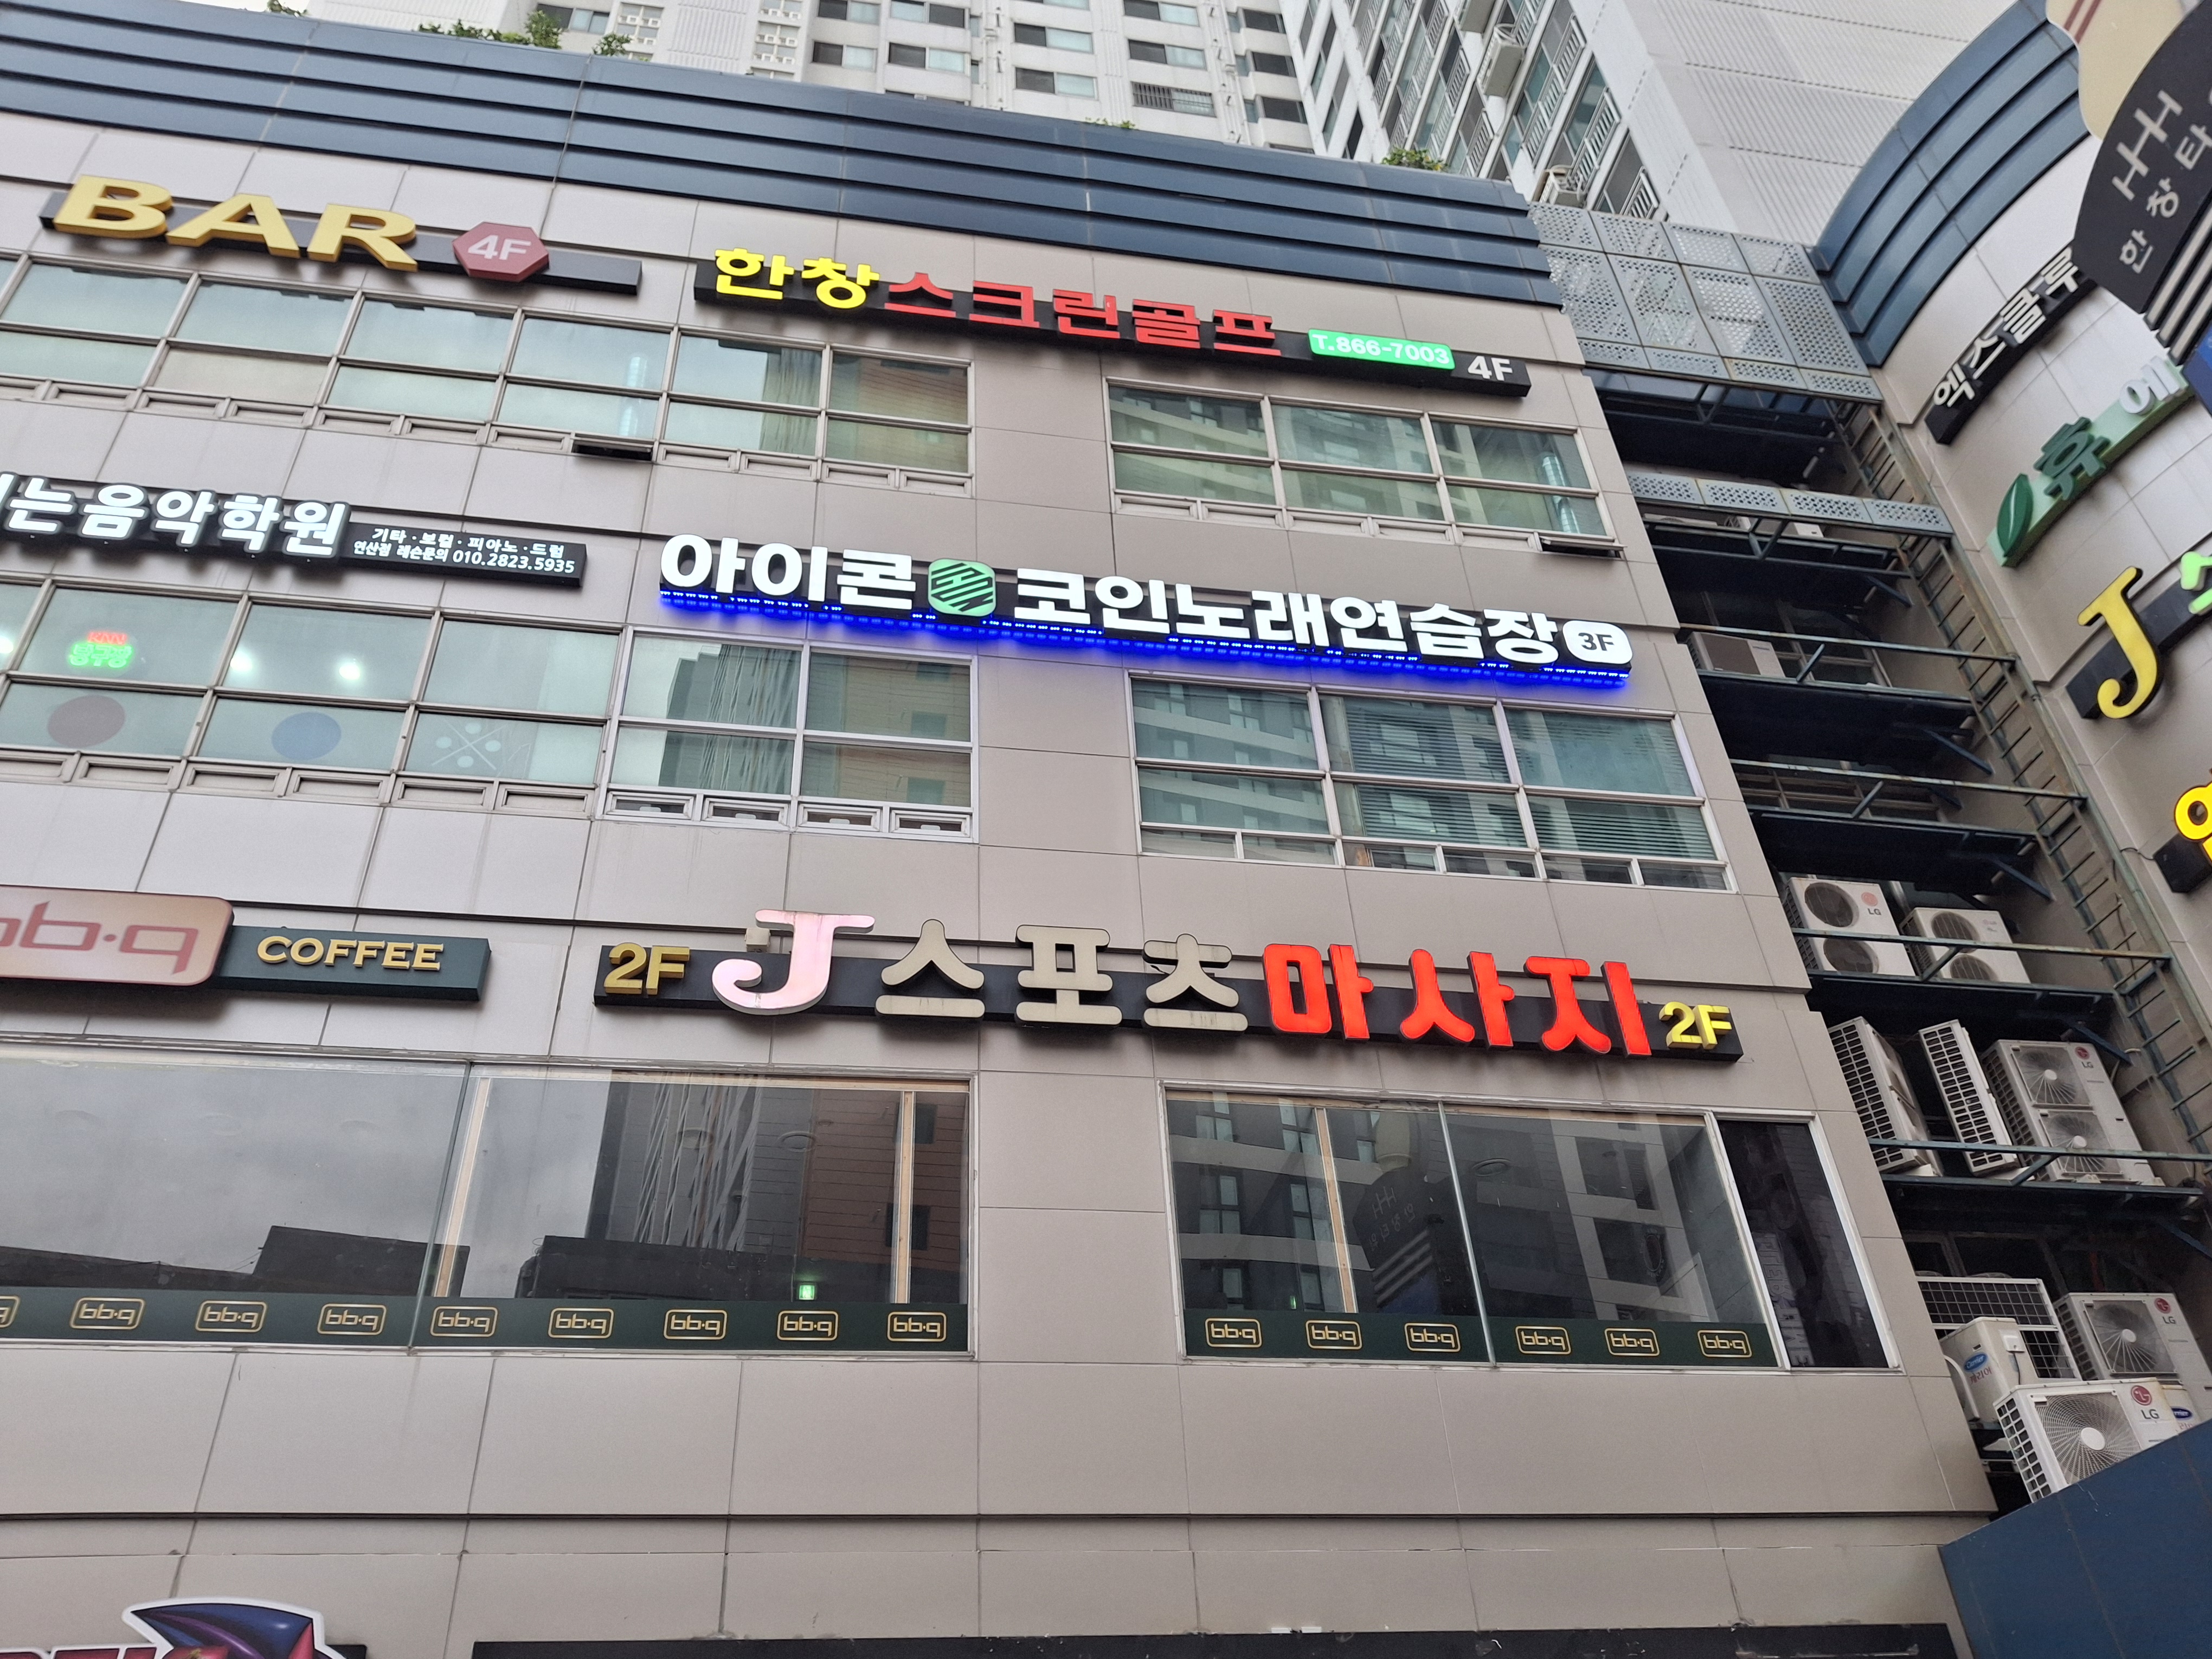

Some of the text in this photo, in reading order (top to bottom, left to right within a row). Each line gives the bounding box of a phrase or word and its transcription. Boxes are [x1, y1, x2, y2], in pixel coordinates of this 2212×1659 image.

[2119, 87, 2212, 273] 한창타
[54, 174, 532, 273] BAR 4F
[1933, 247, 2079, 407] 엑스클루
[1311, 333, 1450, 365] T.866-7003
[1467, 355, 1514, 382] 4F
[354, 541, 575, 574] 연산점 레슨문의 010.2823.5935
[660, 533, 916, 610] 아이콘
[1014, 567, 1559, 664] 코인노래연습장
[1580, 632, 1616, 651] 3F
[1867, 908, 1882, 916] LG
[257, 935, 444, 972] COFFEE
[603, 942, 691, 997] 2F
[1262, 942, 1652, 1058] 마사지
[1658, 1000, 1733, 1051] 2F
[2081, 1060, 2094, 1069] LG
[2162, 1316, 2176, 1324] LG
[2140, 1409, 2159, 1420] LG
